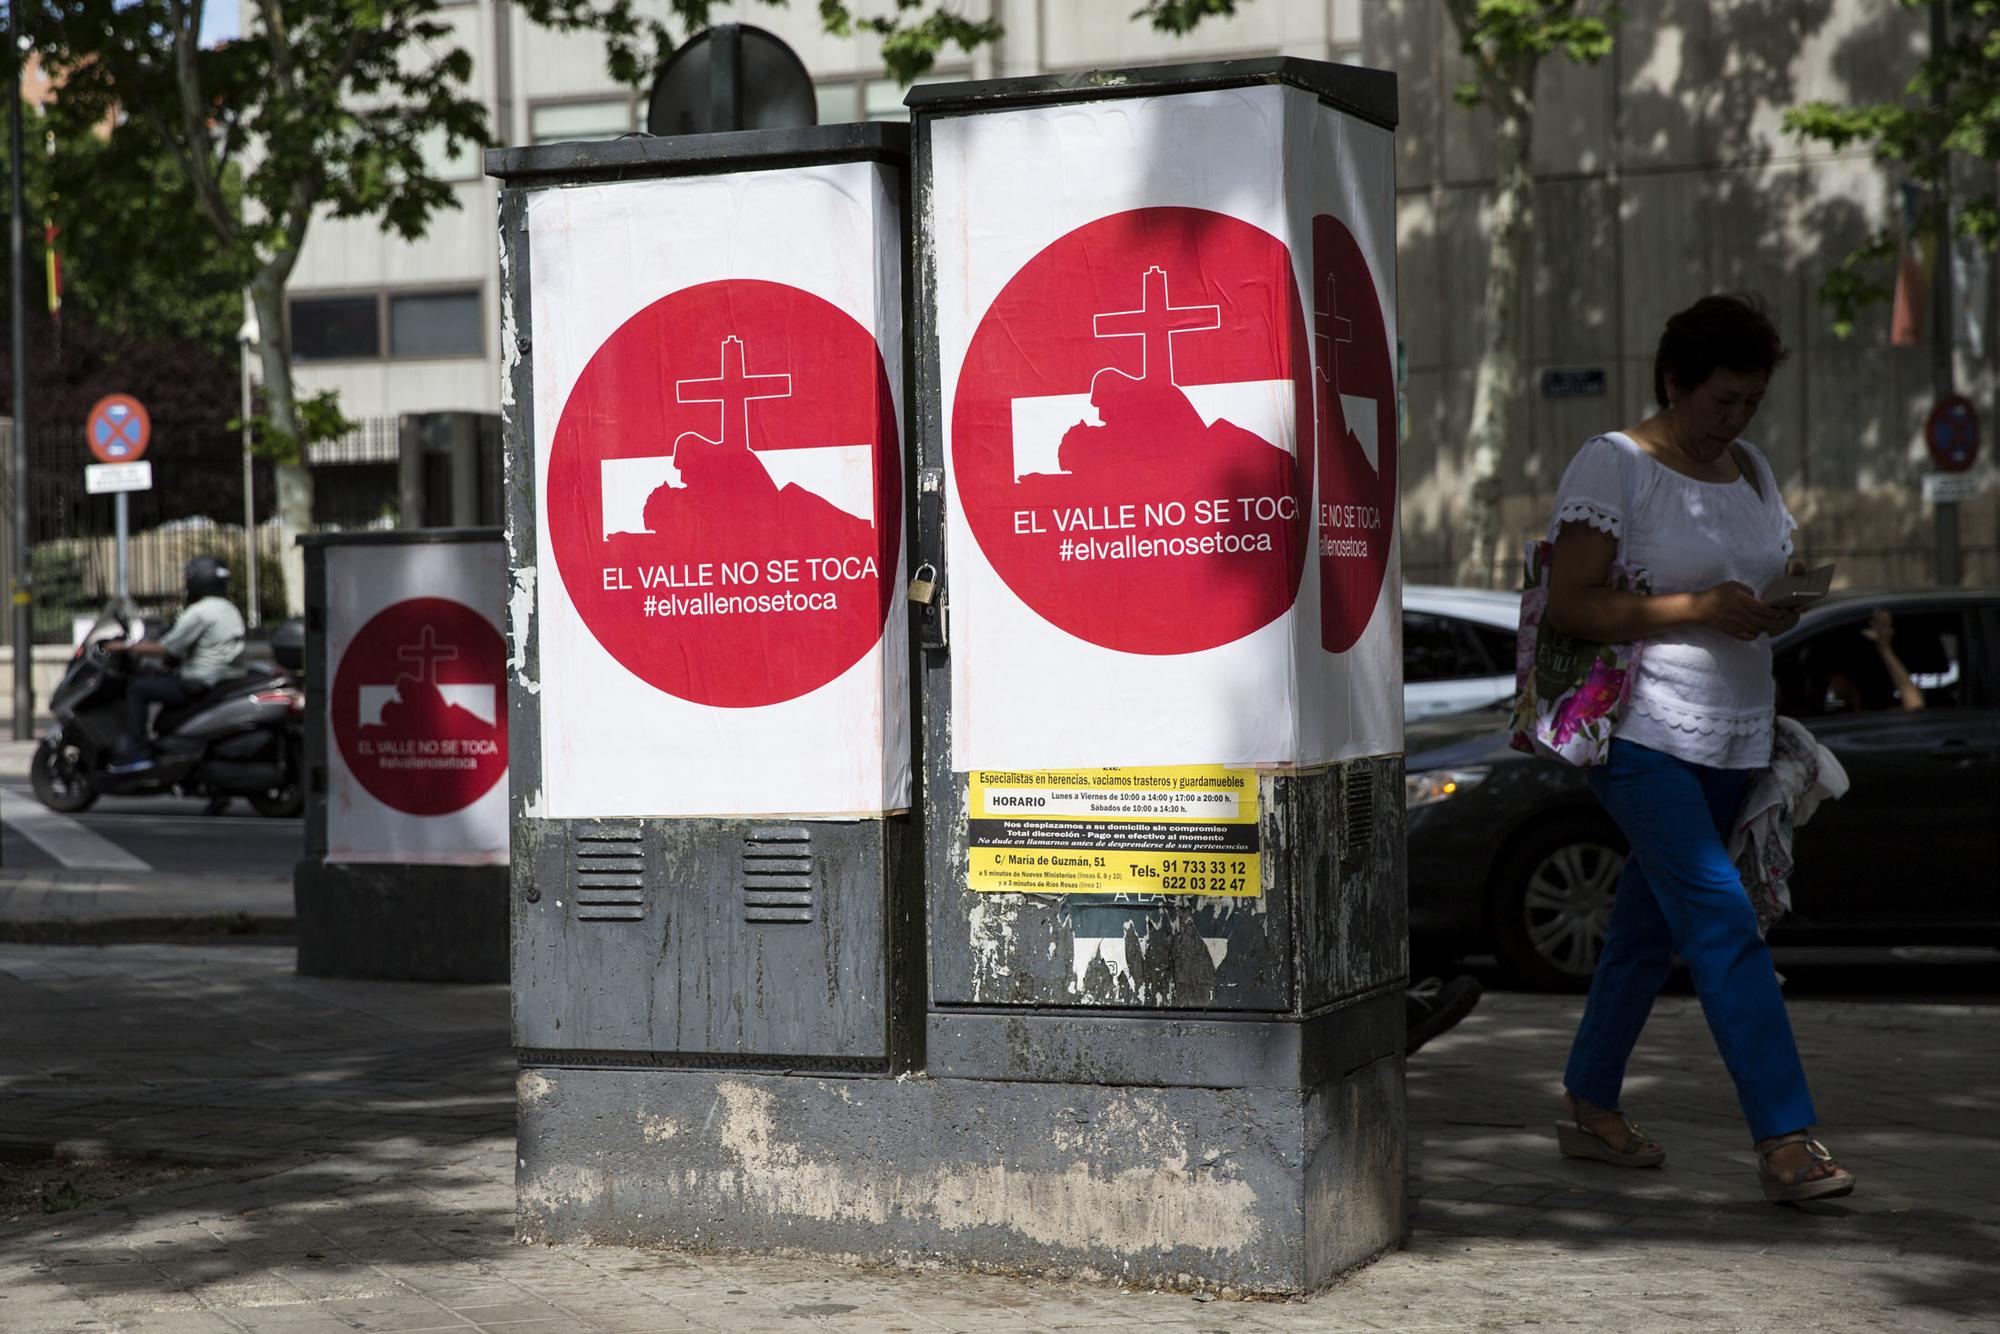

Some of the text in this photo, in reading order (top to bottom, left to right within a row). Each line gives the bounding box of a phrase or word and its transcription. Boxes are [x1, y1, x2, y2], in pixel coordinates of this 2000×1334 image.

[1014, 510, 1046, 533] EL
[1053, 505, 1136, 532] VALLE
[1144, 502, 1187, 527] NO
[1194, 499, 1230, 524] SE
[1329, 504, 1342, 527] NO
[1344, 505, 1355, 528] SE
[1356, 506, 1381, 529] TOCA
[1059, 533, 1272, 561] #elvallenosetoca
[602, 556, 879, 590] EL VALLE NO SE TOCA
[643, 589, 838, 617] #elvallenosetoca
[358, 739, 498, 754] EL VALLE NO SE TOCA
[980, 772, 1034, 785] Especialistas
[1036, 776, 1046, 784] en
[1092, 774, 1132, 786] vaciamos
[1133, 775, 1171, 787] trasteros
[1172, 779, 1178, 788] y
[1179, 776, 1245, 789] guardamuebles
[993, 796, 1046, 807] HORARIO
[1051, 792, 1073, 800] Lunes
[1080, 792, 1108, 800] Viernes
[1109, 793, 1119, 801] de
[1120, 793, 1140, 801] 10:00
[1175, 794, 1196, 802] 17:00
[1203, 794, 1224, 802] 20:00
[1225, 795, 1232, 803] h.
[1133, 804, 1152, 812] 10:00
[1160, 805, 1180, 813] 14:30
[1023, 821, 1084, 829] desplazamos
[1168, 825, 1228, 833] compromiso
[1007, 829, 1030, 837] Total
[1087, 831, 1112, 840] Pago
[1026, 838, 1069, 846] llamarnos
[1107, 840, 1164, 849] desprenderse
[1193, 842, 1249, 851] pertenencias
[995, 854, 1006, 866] C/
[1037, 856, 1049, 865] de
[1094, 857, 1106, 867] 51
[1163, 860, 1246, 874] 91 733 33 12
[1130, 864, 1160, 878] Tels.
[1163, 877, 1246, 891] 622 03 22 47
